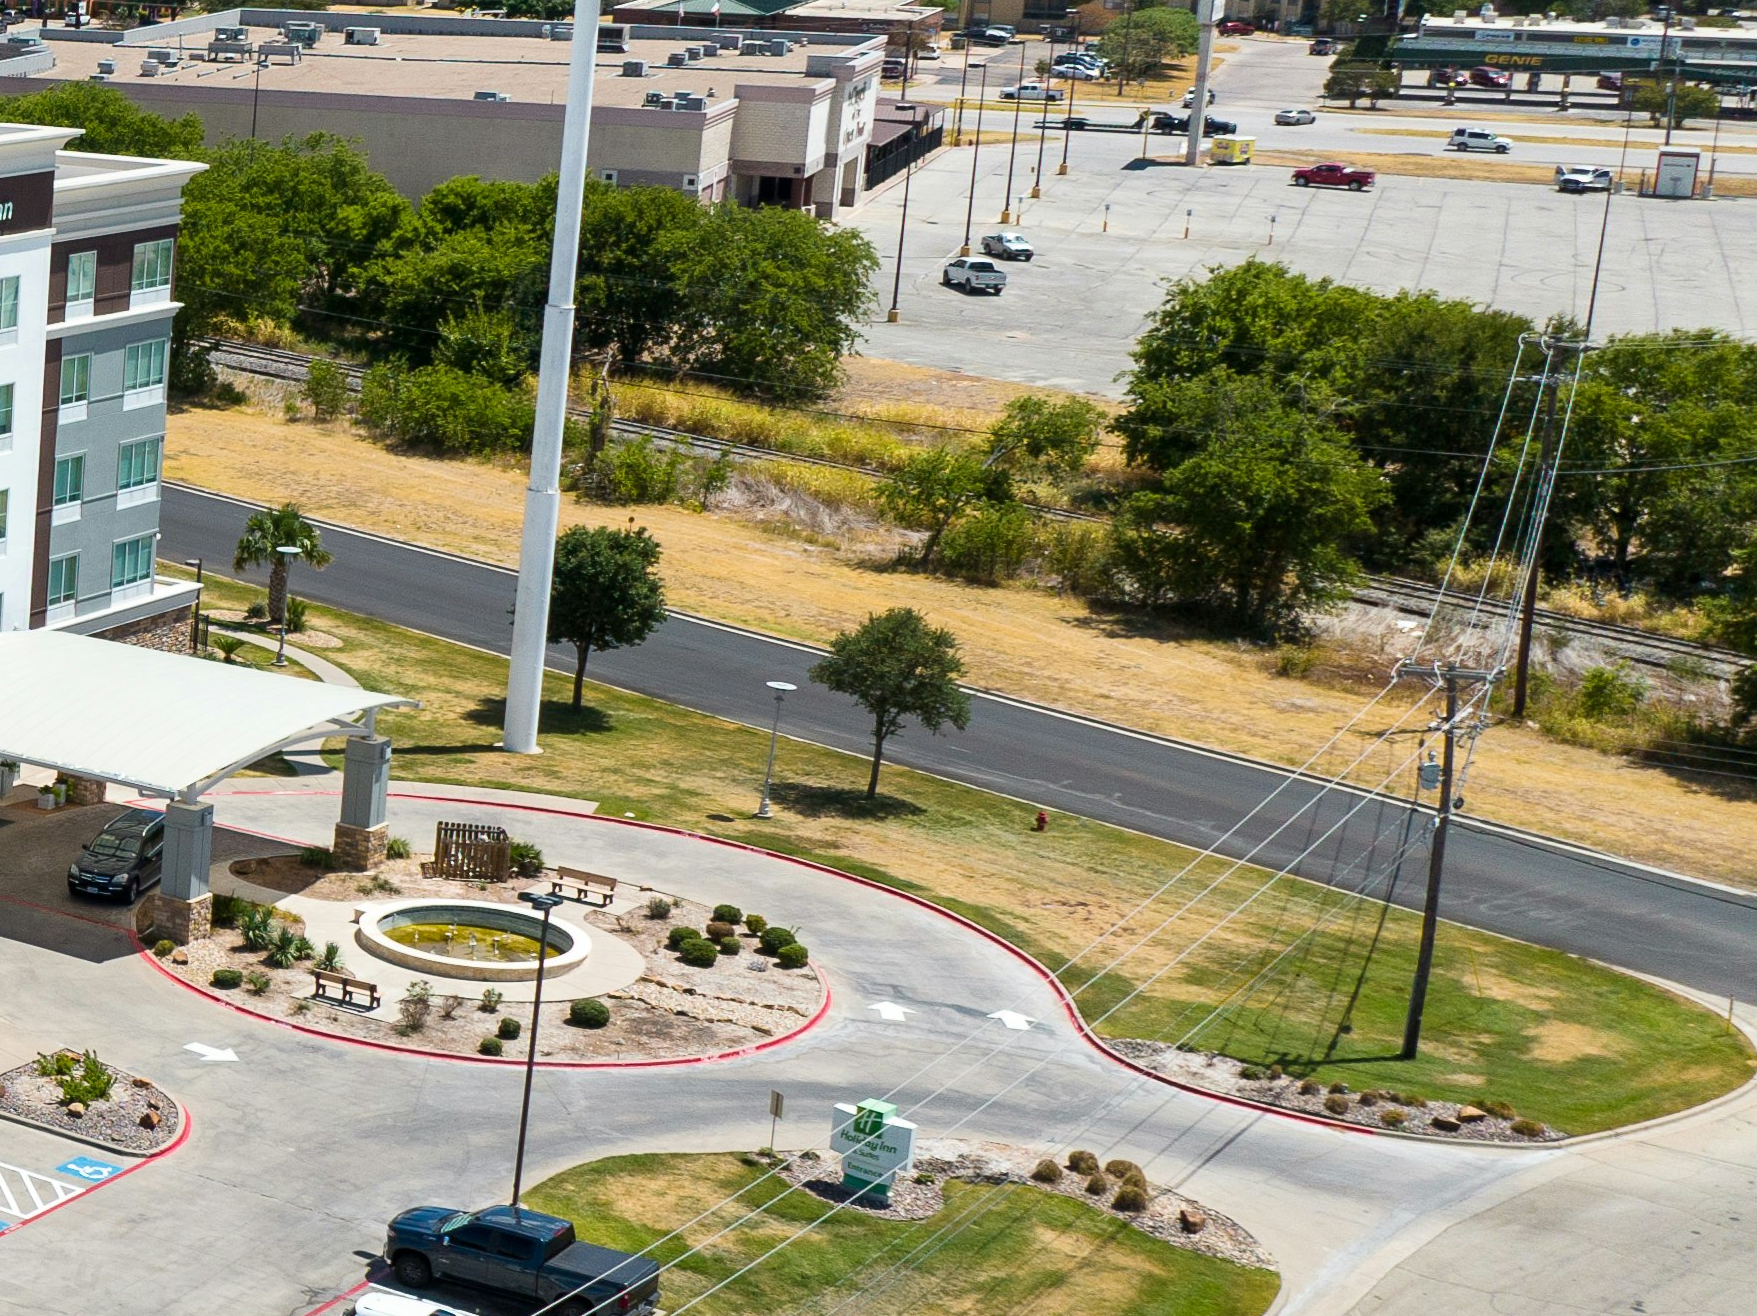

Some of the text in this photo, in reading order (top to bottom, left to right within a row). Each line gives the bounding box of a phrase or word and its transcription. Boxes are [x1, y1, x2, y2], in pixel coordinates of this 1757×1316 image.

[1484, 53, 1543, 66] GENIE
[840, 1128, 897, 1155] Holiday Inn
